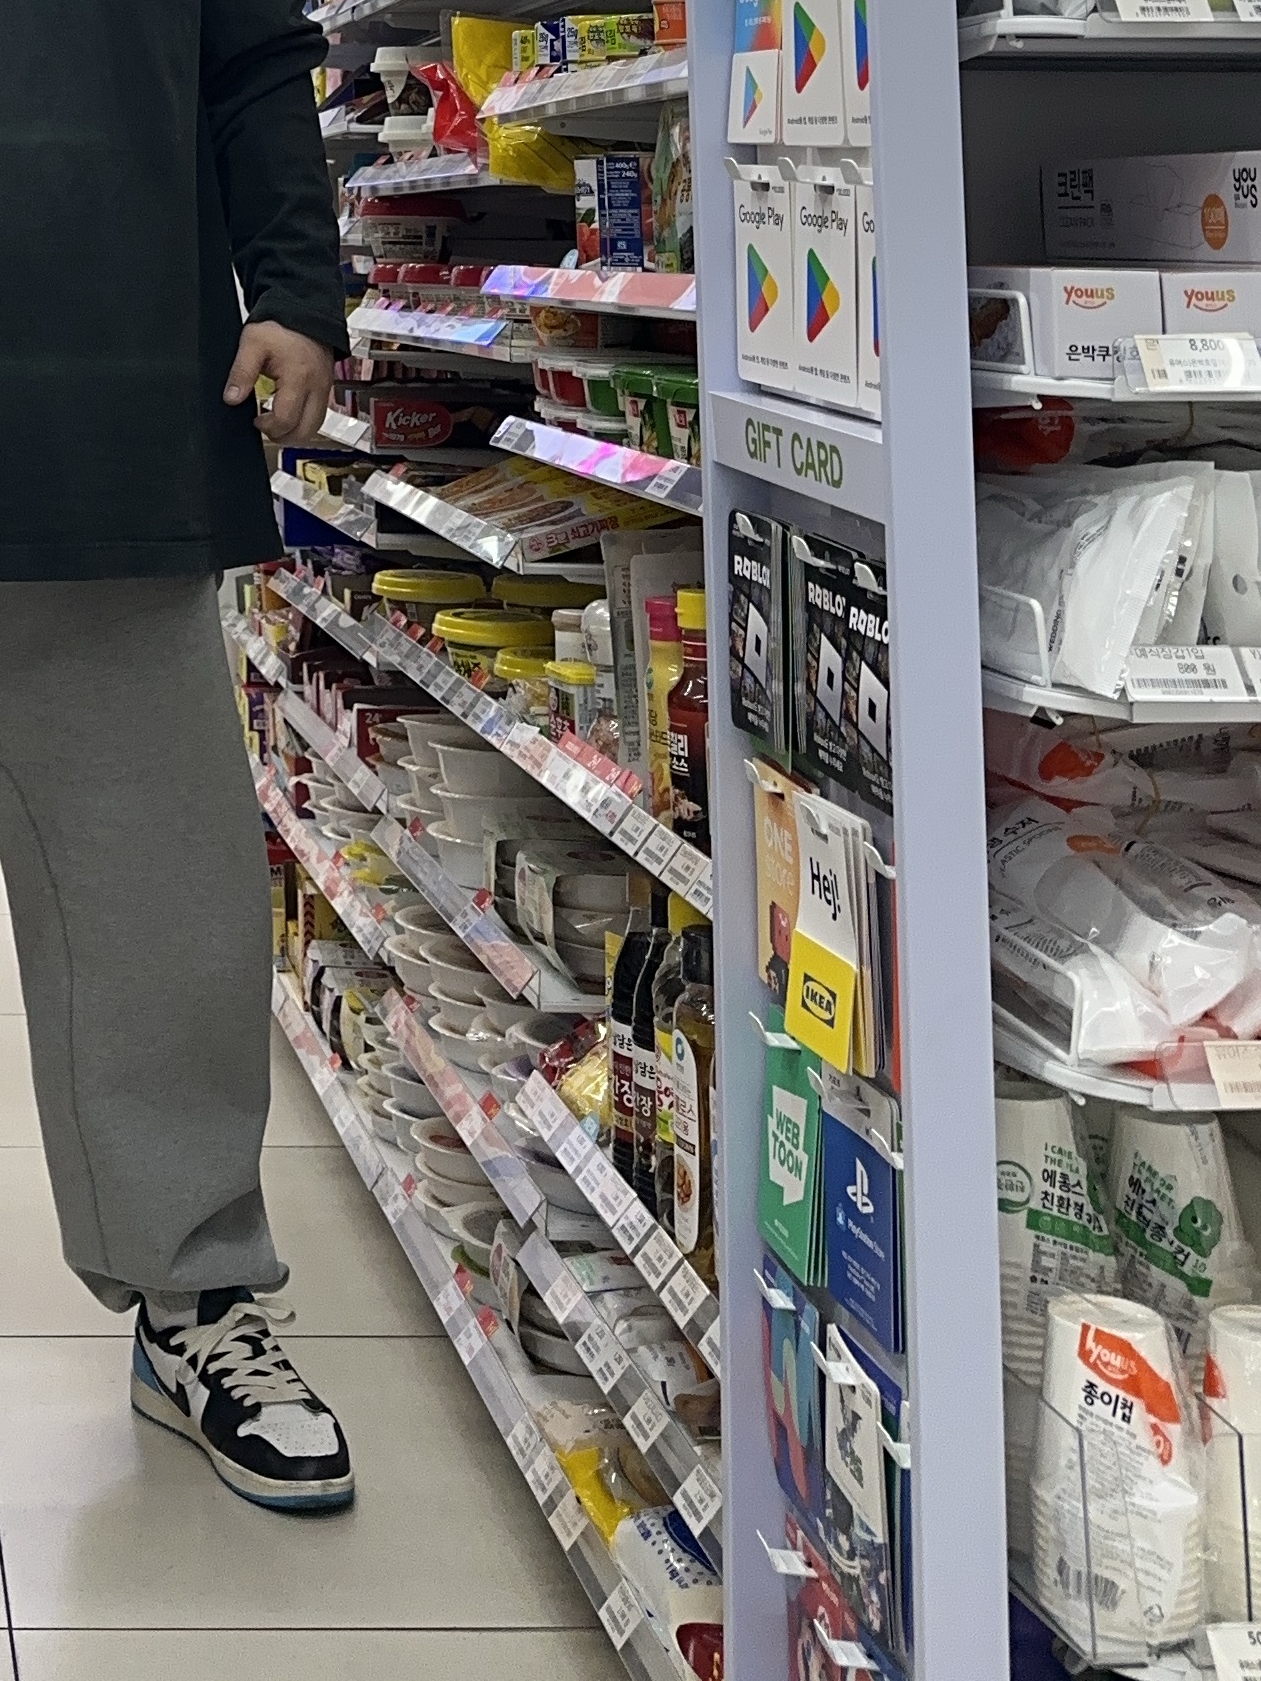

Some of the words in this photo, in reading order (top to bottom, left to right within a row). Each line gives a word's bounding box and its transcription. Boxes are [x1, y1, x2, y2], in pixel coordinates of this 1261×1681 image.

[738, 204, 766, 231] Google
[766, 208, 784, 232] Play
[799, 207, 829, 235] Google
[830, 209, 848, 236] Play
[1063, 285, 1115, 306] youus
[1183, 288, 1236, 309] youus
[385, 407, 437, 429] Kicker
[745, 416, 783, 469] GIFT
[790, 431, 843, 490] CARD
[809, 856, 842, 922] Hej!
[805, 984, 836, 1017] IKEA
[776, 1107, 801, 1151] WEB
[772, 1137, 805, 1183] TOON
[1081, 1379, 1134, 1425] 종이컵
